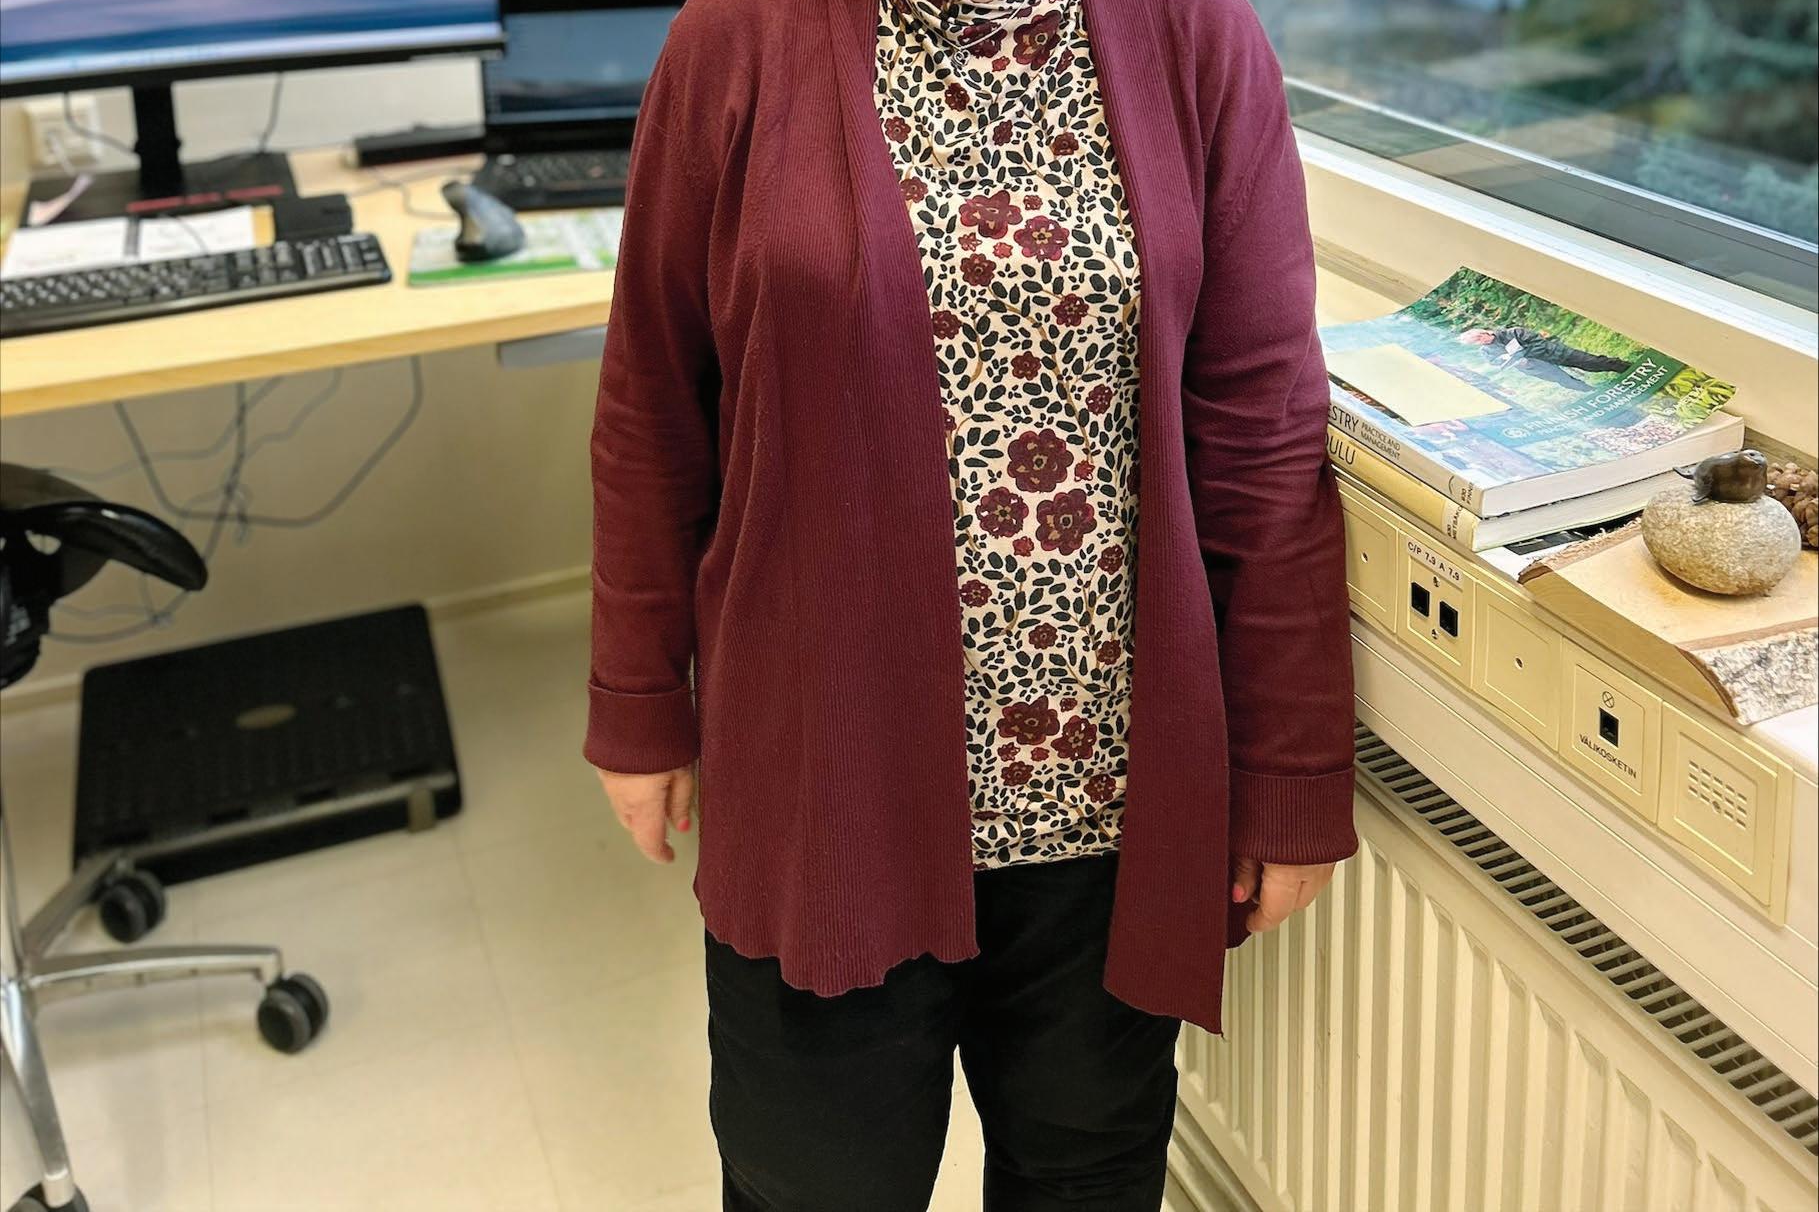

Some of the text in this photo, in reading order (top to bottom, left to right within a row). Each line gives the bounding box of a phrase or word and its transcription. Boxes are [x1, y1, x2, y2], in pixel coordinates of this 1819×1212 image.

[1523, 357, 1657, 431] FINNISH FORESTRY
[1583, 409, 1605, 423] AND
[1604, 365, 1668, 412] MANAGEMENT
[1361, 421, 1401, 452] PRACTICE AND
[1408, 541, 1422, 555] C/P
[1439, 562, 1446, 572] A
